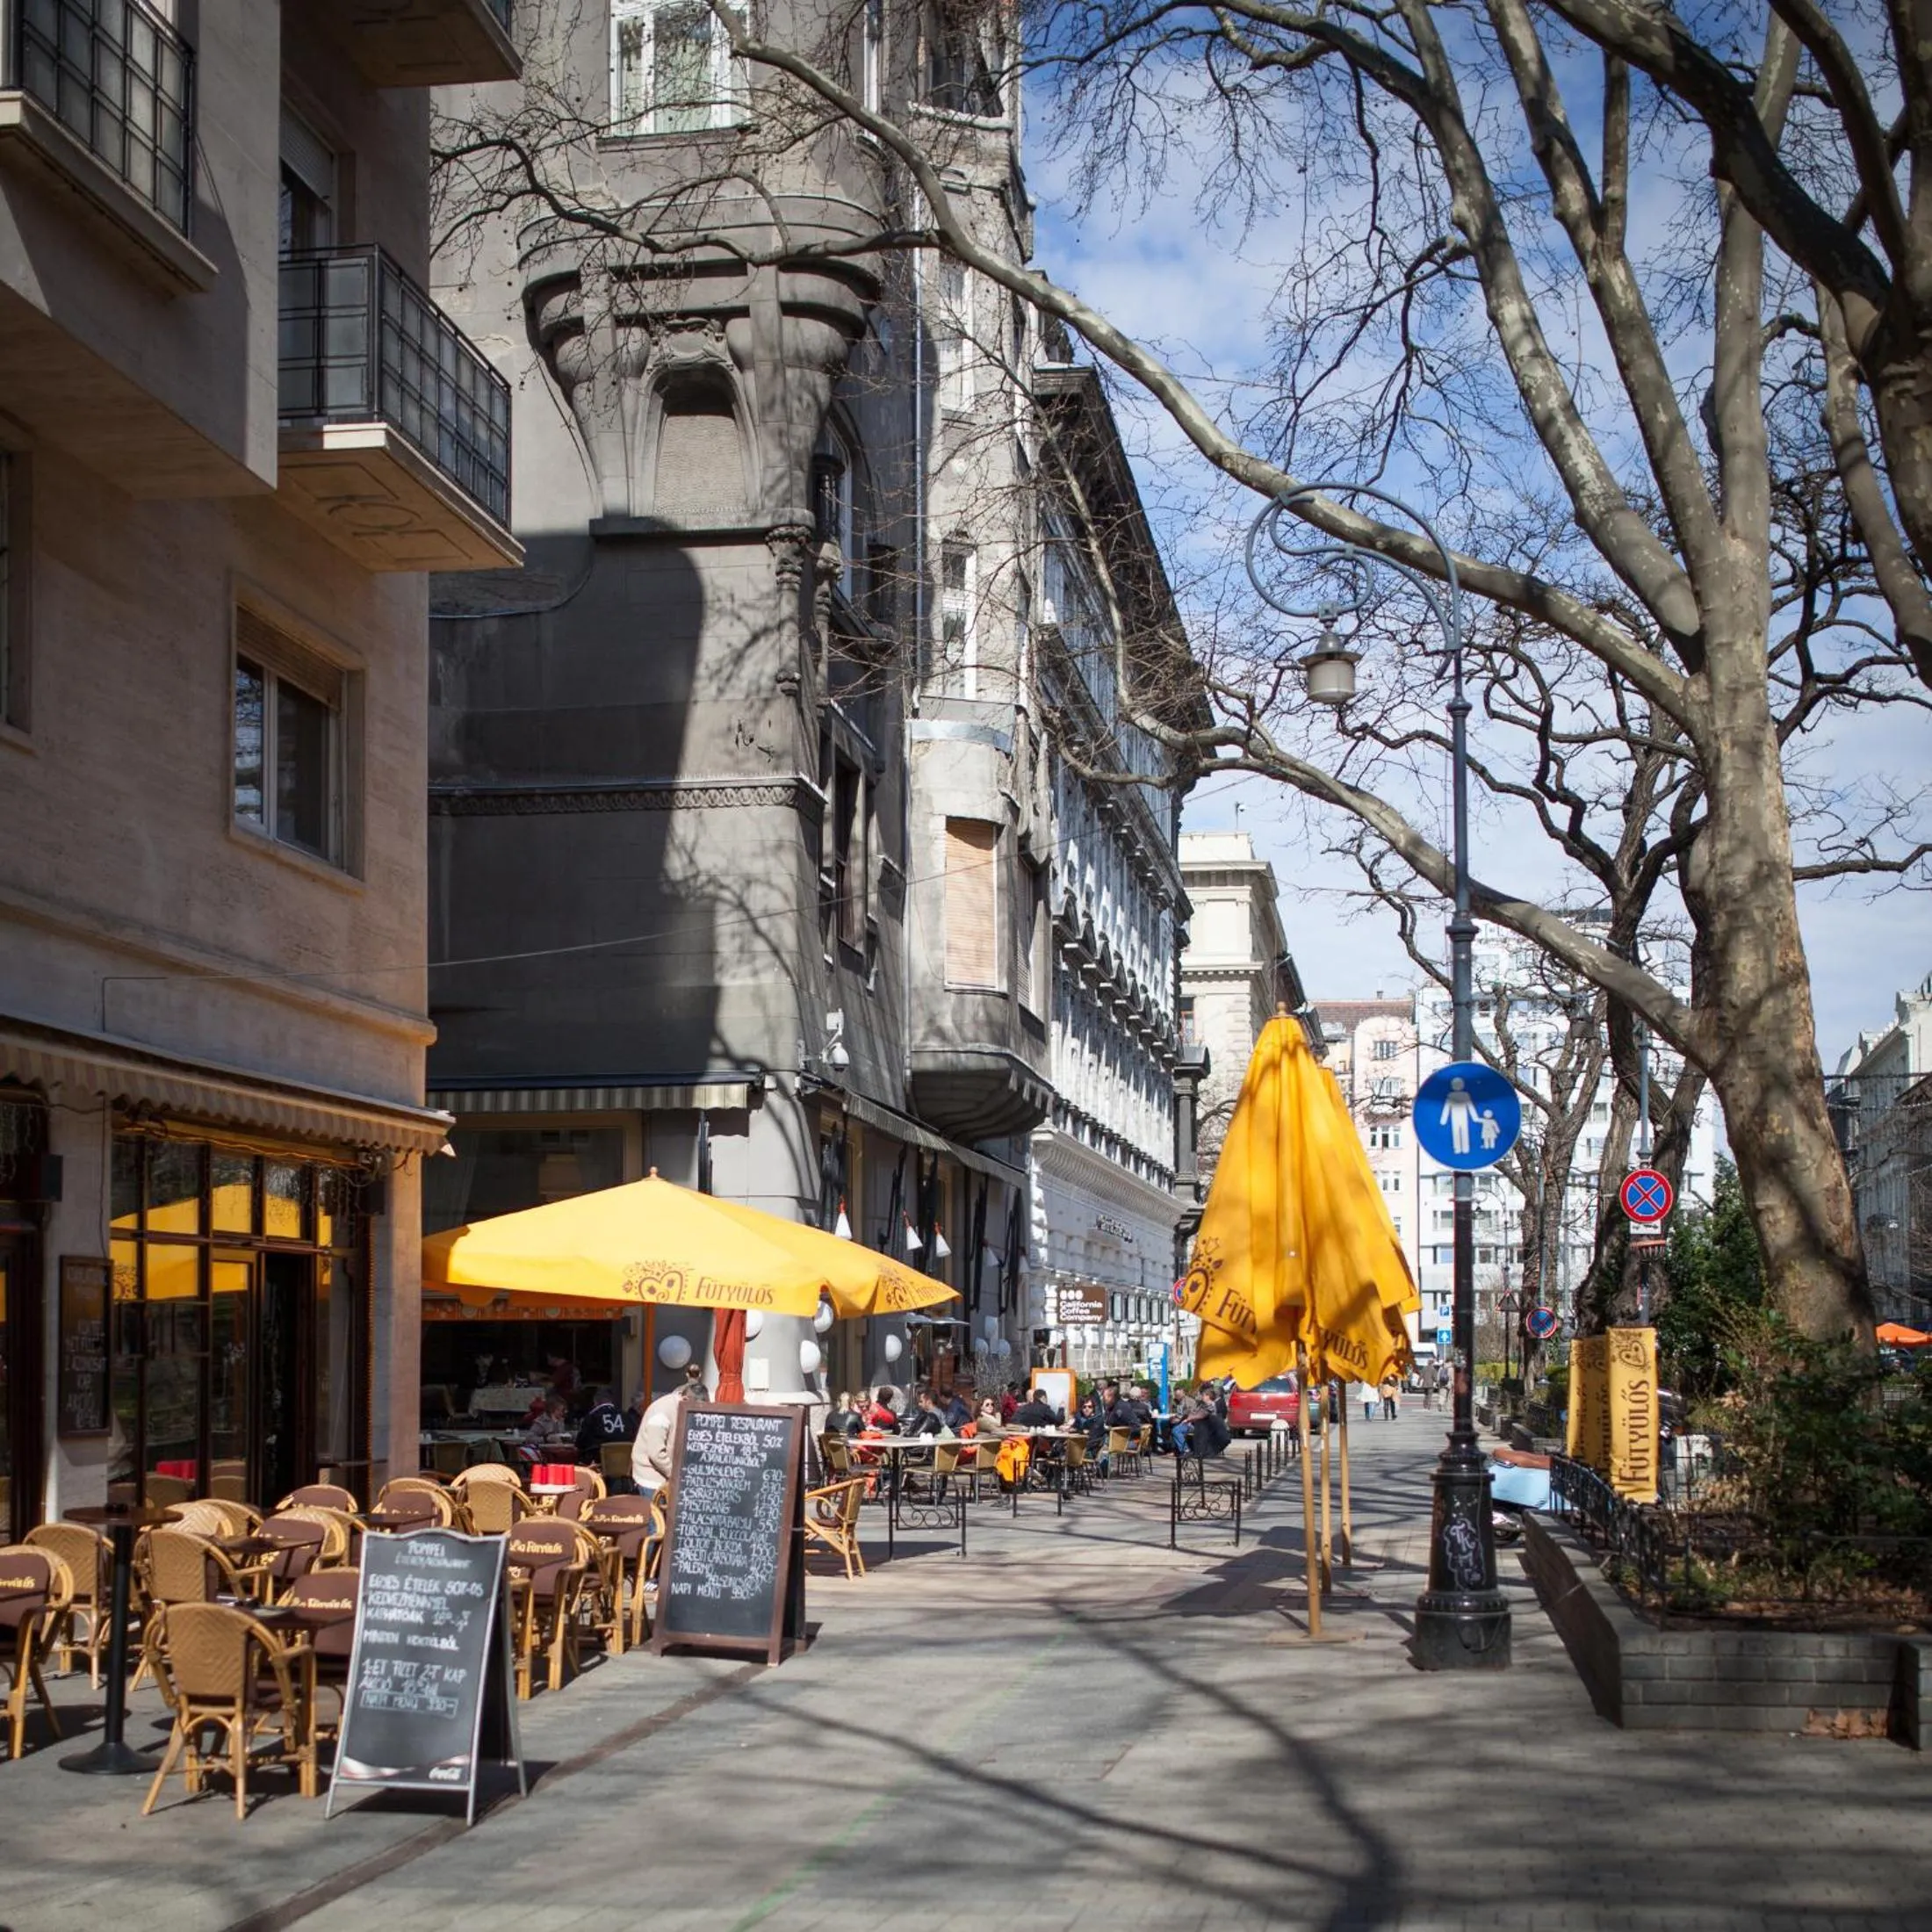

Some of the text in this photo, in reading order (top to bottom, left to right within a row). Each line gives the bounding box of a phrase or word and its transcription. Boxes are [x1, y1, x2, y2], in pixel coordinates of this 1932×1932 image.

[602, 1414, 624, 1433] 54
[762, 1434, 784, 1448] 50%
[671, 1582, 691, 1595] NAPI
